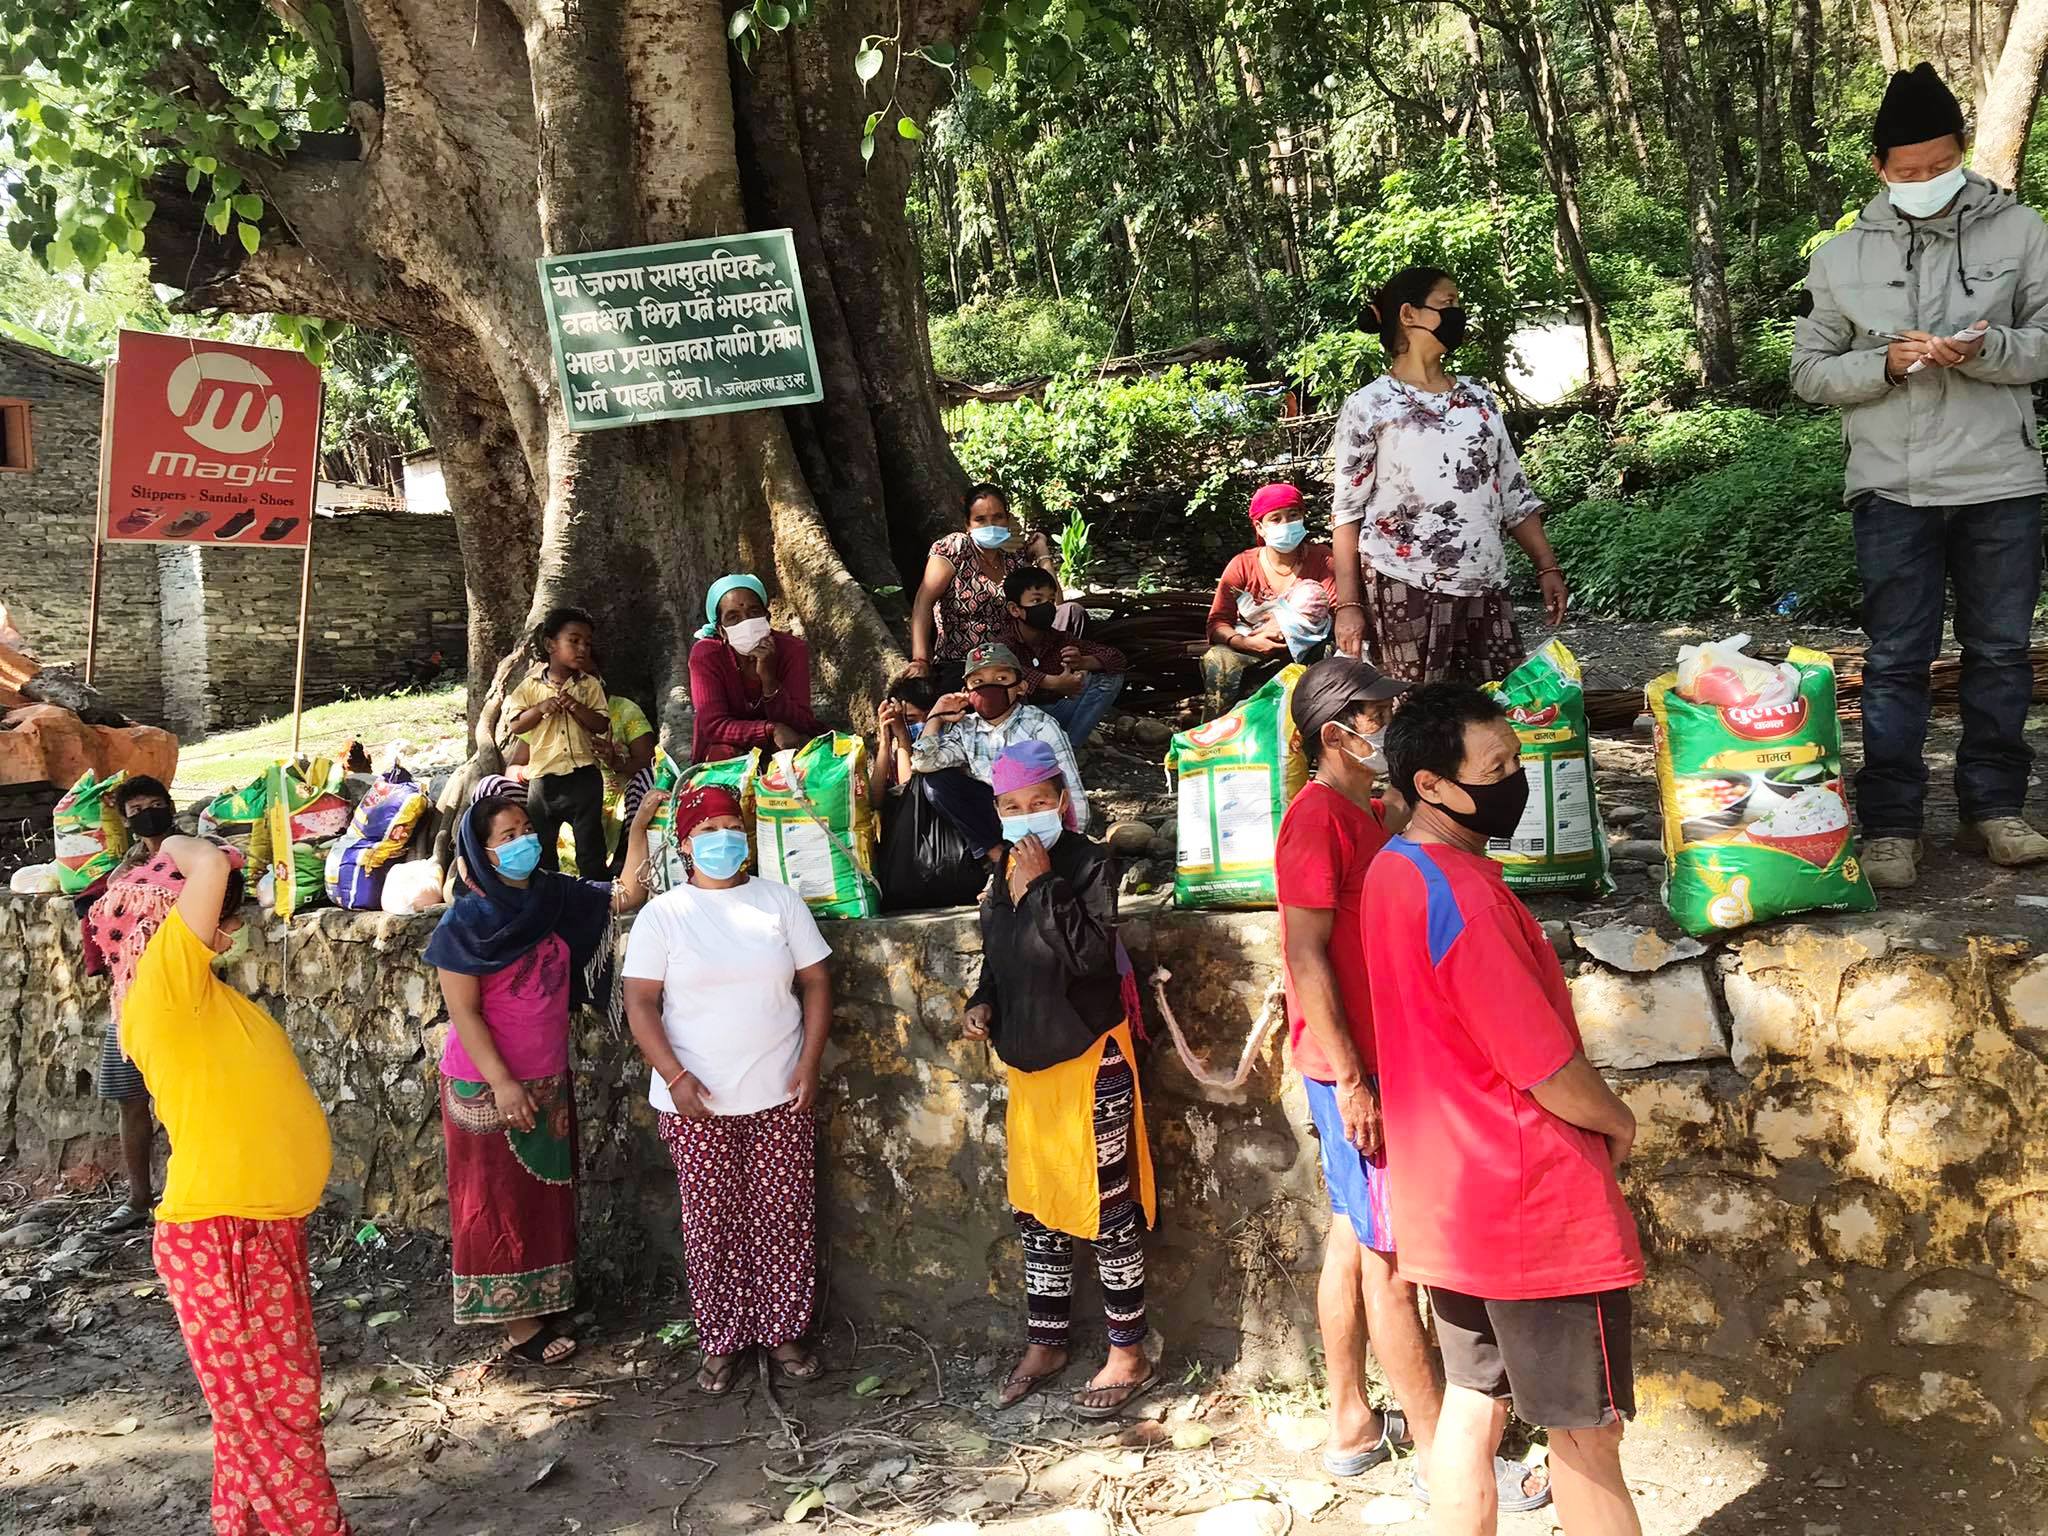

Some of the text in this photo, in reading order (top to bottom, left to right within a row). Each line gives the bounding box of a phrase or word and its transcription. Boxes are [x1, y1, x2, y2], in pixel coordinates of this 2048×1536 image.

[551, 249, 776, 298] यो जग्गा सामुदायिक
[559, 279, 794, 337] वनक्षेत्र भित्र पर्ने भएकोले
[565, 319, 803, 375] भाडा प्रयोजनका लागि प्रयोग
[573, 380, 609, 414] गर्न
[612, 372, 667, 409] पाइने
[131, 485, 186, 502] Slippers
[199, 489, 248, 505] Sandals
[259, 493, 295, 506] Shoes
[1756, 752, 1792, 764] चामल
